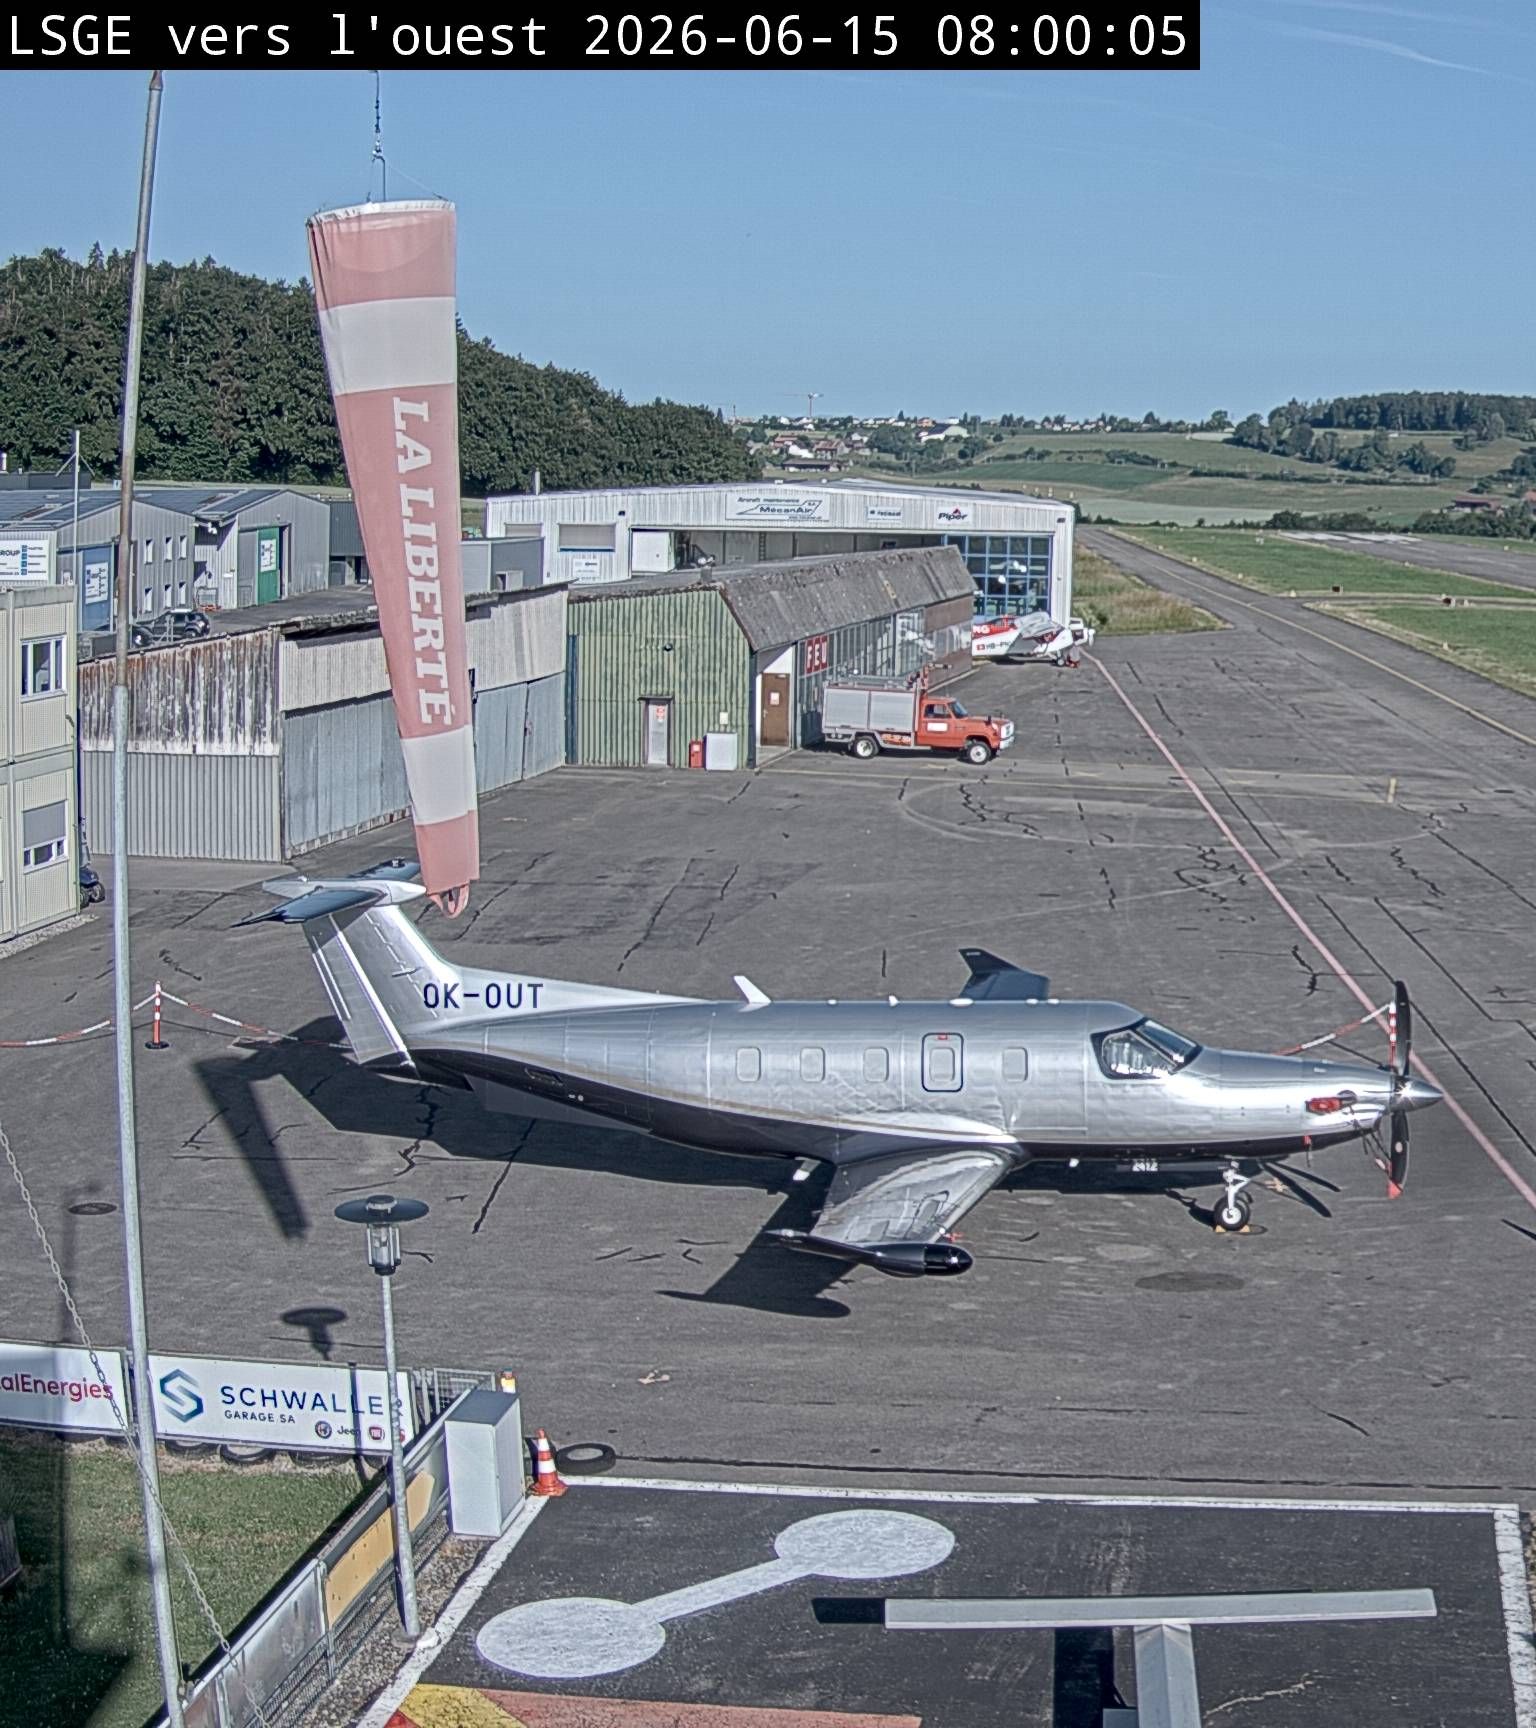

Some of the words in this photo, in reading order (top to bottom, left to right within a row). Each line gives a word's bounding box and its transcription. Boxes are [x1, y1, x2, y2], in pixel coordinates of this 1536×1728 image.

[393, 396, 432, 474] LA
[938, 511, 968, 520] Piper
[399, 483, 456, 725] LIBERTÉ
[807, 642, 827, 668] FEU
[423, 983, 543, 1009] OK-OUT
[0, 1373, 113, 1402] alEnergies
[224, 1410, 275, 1422] GARAGE
[280, 1413, 296, 1424] SA
